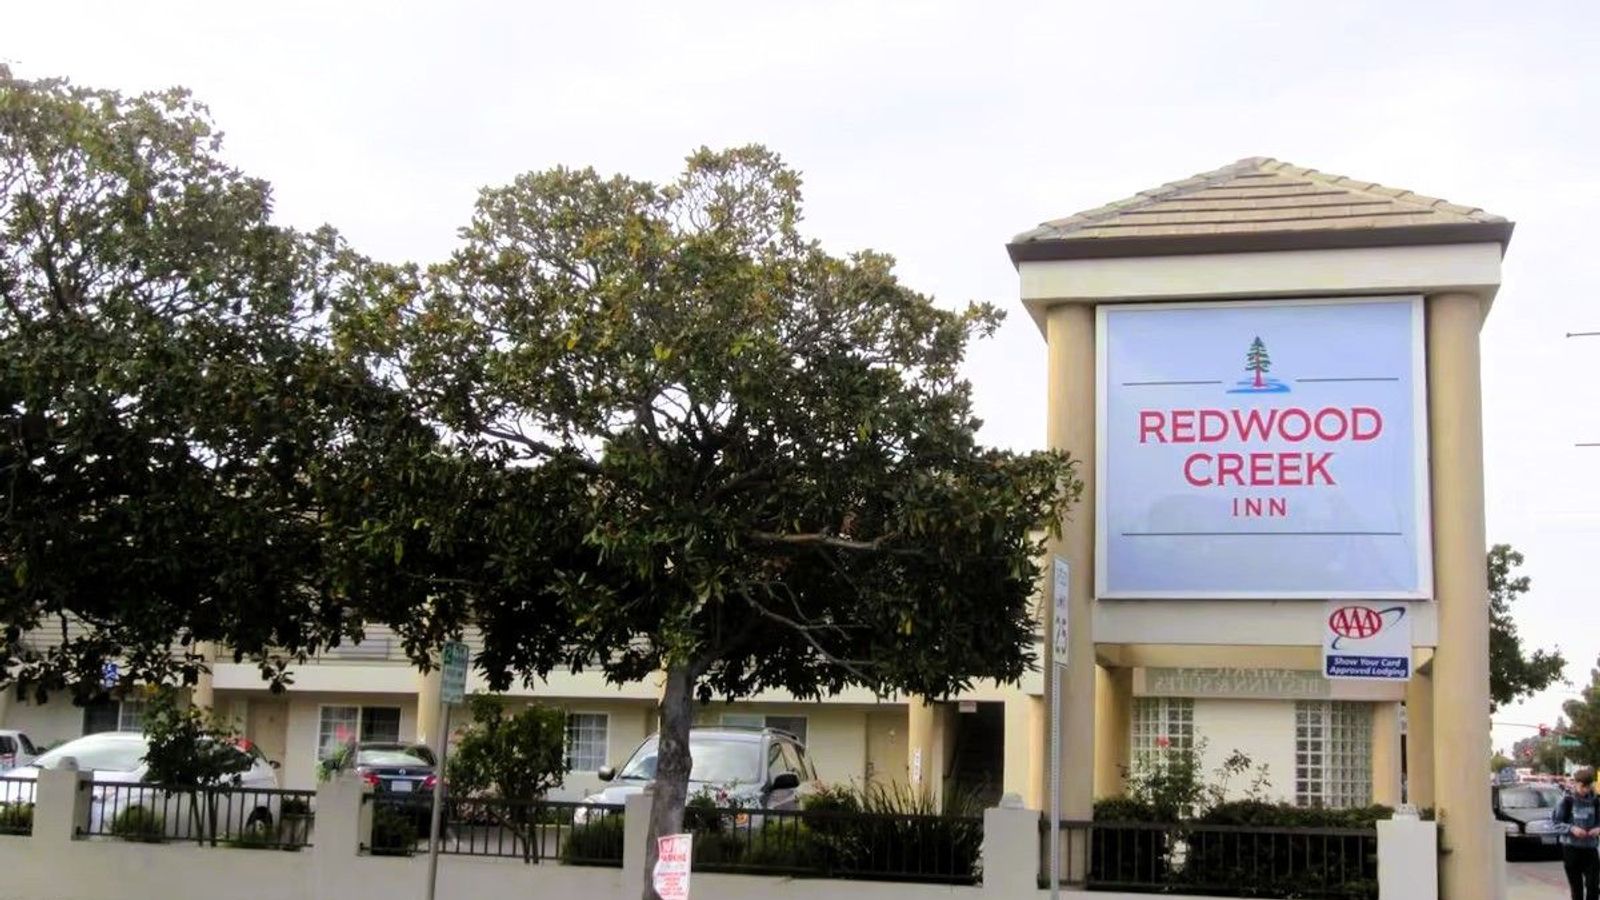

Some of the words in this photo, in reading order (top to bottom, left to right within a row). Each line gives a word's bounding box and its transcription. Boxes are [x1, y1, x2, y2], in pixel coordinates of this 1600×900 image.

[1138, 407, 1383, 444] REDWOOD
[1183, 452, 1336, 487] CREEK
[1232, 497, 1288, 517] INN
[1333, 607, 1379, 638] AAA
[1329, 665, 1371, 675] Approved
[1372, 667, 1407, 677] Lodging
[1334, 657, 1358, 666] Show
[1360, 658, 1380, 666] Your
[1381, 658, 1401, 667] Card
